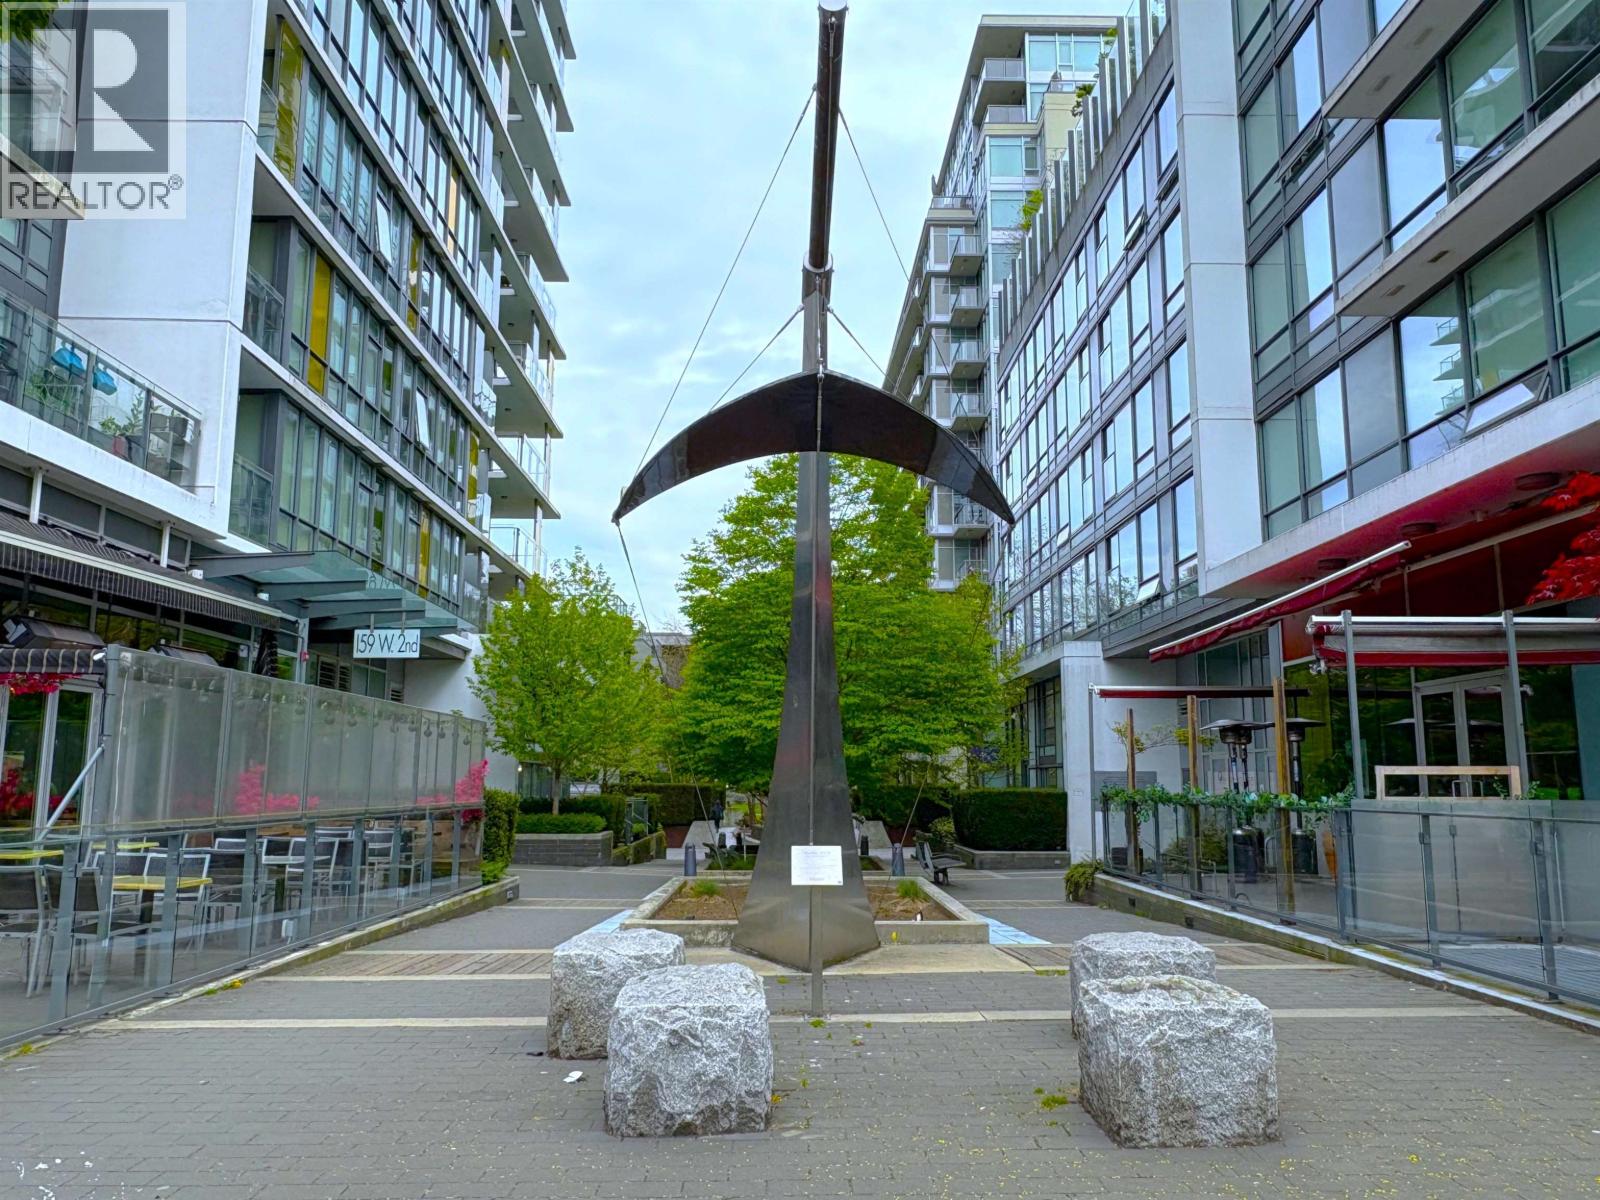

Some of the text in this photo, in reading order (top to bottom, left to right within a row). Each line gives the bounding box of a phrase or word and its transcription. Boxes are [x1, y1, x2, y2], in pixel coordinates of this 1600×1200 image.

[356, 633, 419, 654] 159 W. 2nd
